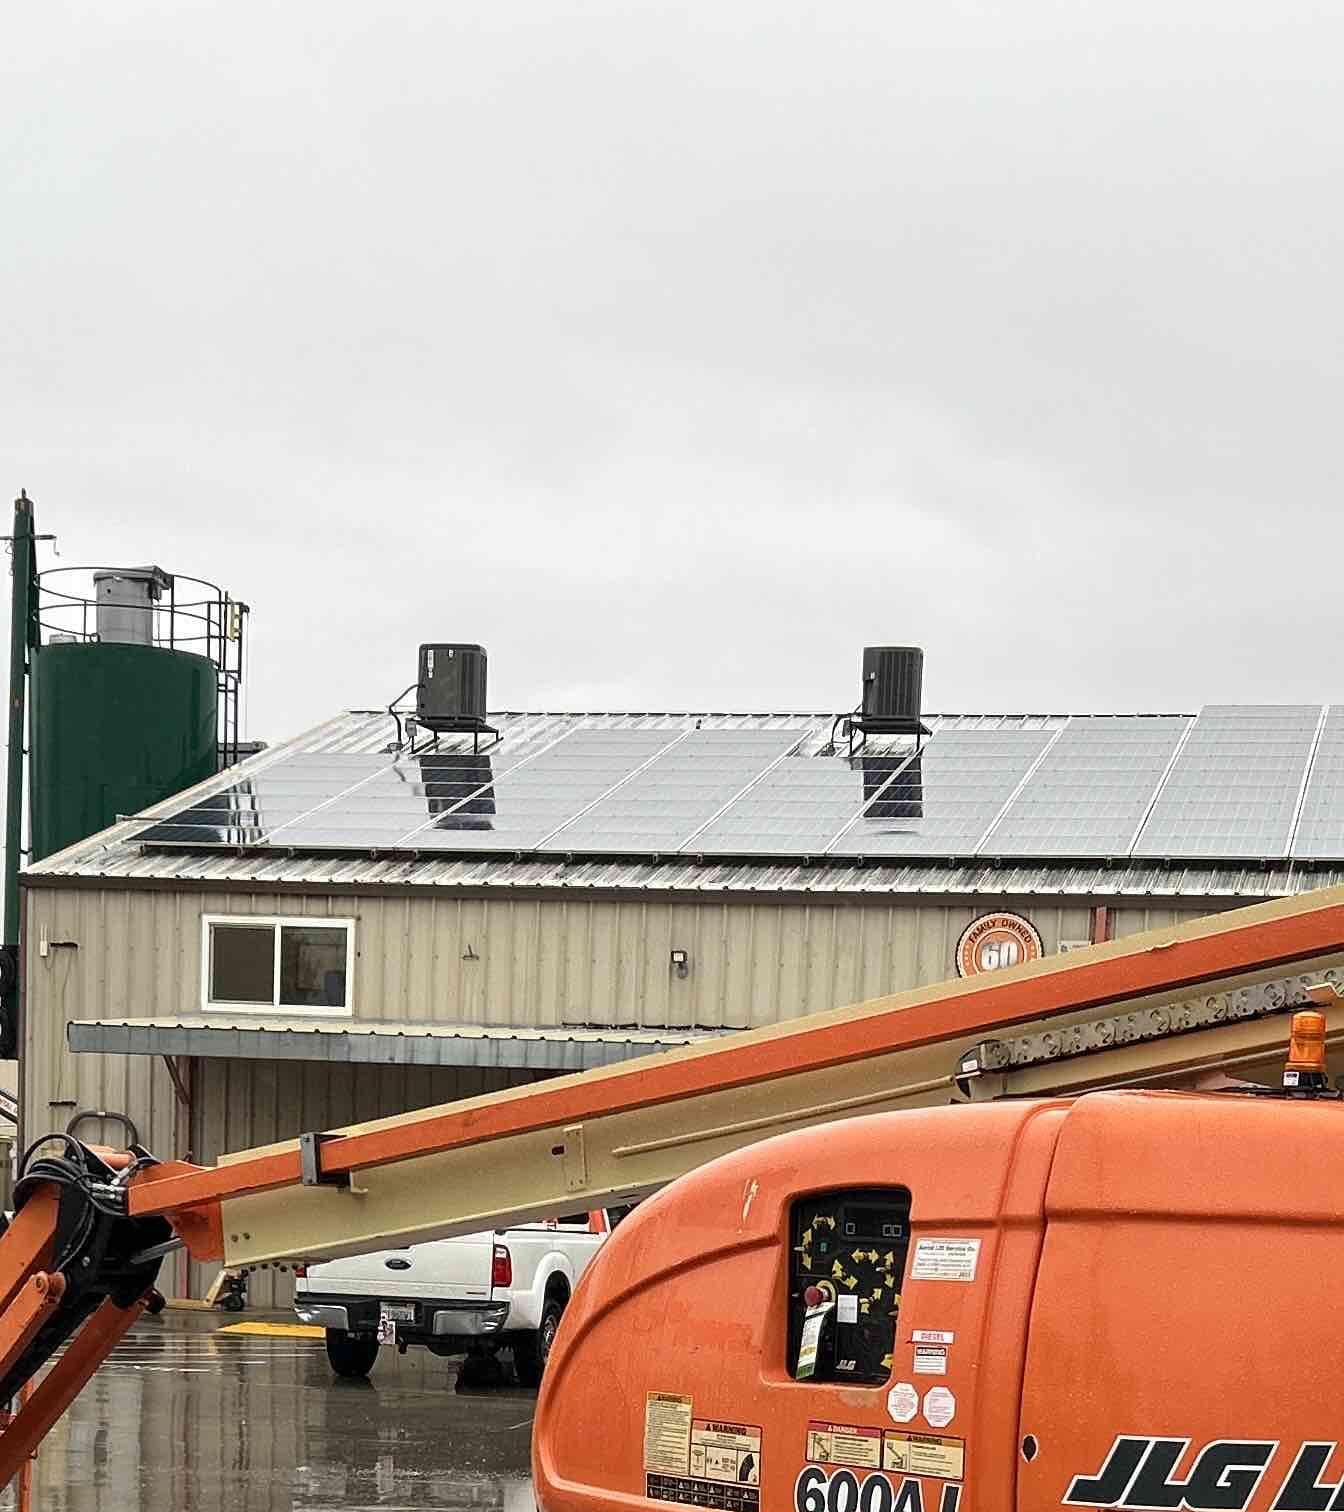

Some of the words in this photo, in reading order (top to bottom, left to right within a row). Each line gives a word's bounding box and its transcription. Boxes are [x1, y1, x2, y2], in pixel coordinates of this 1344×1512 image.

[968, 919, 997, 944] FAMILY
[1001, 919, 1033, 943] OWNED
[712, 1424, 747, 1436] WARNING
